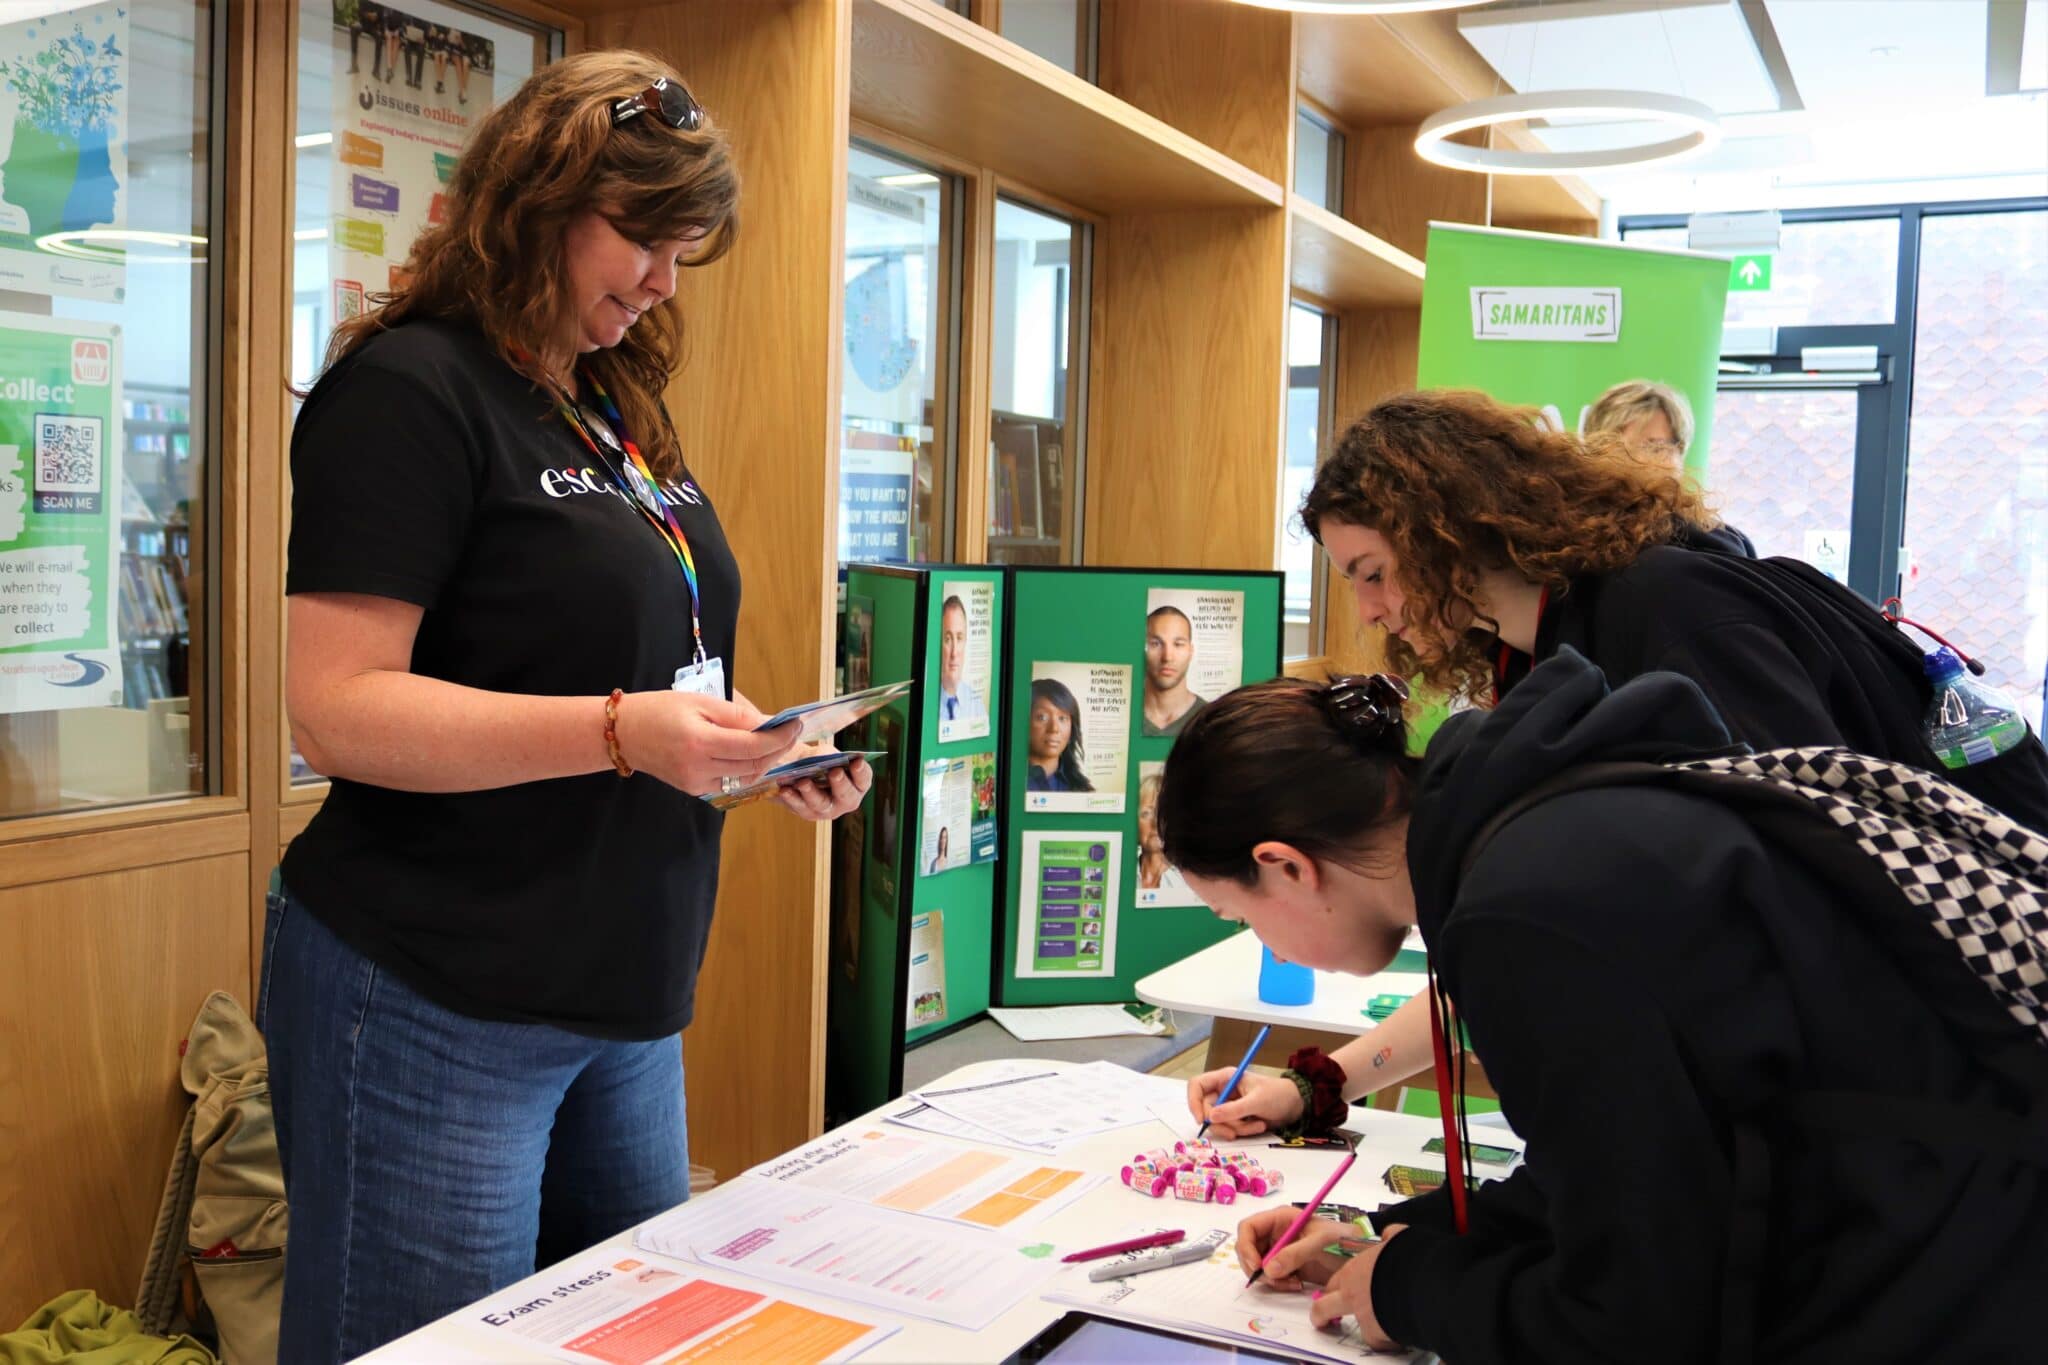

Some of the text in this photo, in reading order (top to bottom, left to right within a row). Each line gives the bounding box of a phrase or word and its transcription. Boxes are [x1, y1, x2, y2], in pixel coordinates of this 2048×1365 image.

[376, 90, 469, 127] issues online
[1489, 303, 1607, 326] SAMARITANS
[42, 496, 93, 510] SCAN ME
[855, 488, 871, 502] YOU
[872, 488, 894, 502] WANT
[896, 488, 907, 503] TO
[864, 510, 881, 524] THE
[881, 510, 907, 525] WORLD
[864, 532, 881, 547] YOU
[882, 532, 898, 547] ARE
[16, 560, 35, 573] will
[38, 560, 73, 573] e-mail
[2, 580, 62, 596] when they
[0, 601, 68, 616] are ready to
[15, 621, 55, 634] collect
[759, 1158, 806, 1178] Looking
[803, 1147, 826, 1160] after
[778, 1164, 814, 1181] mental
[480, 1270, 612, 1327] Exam stress
